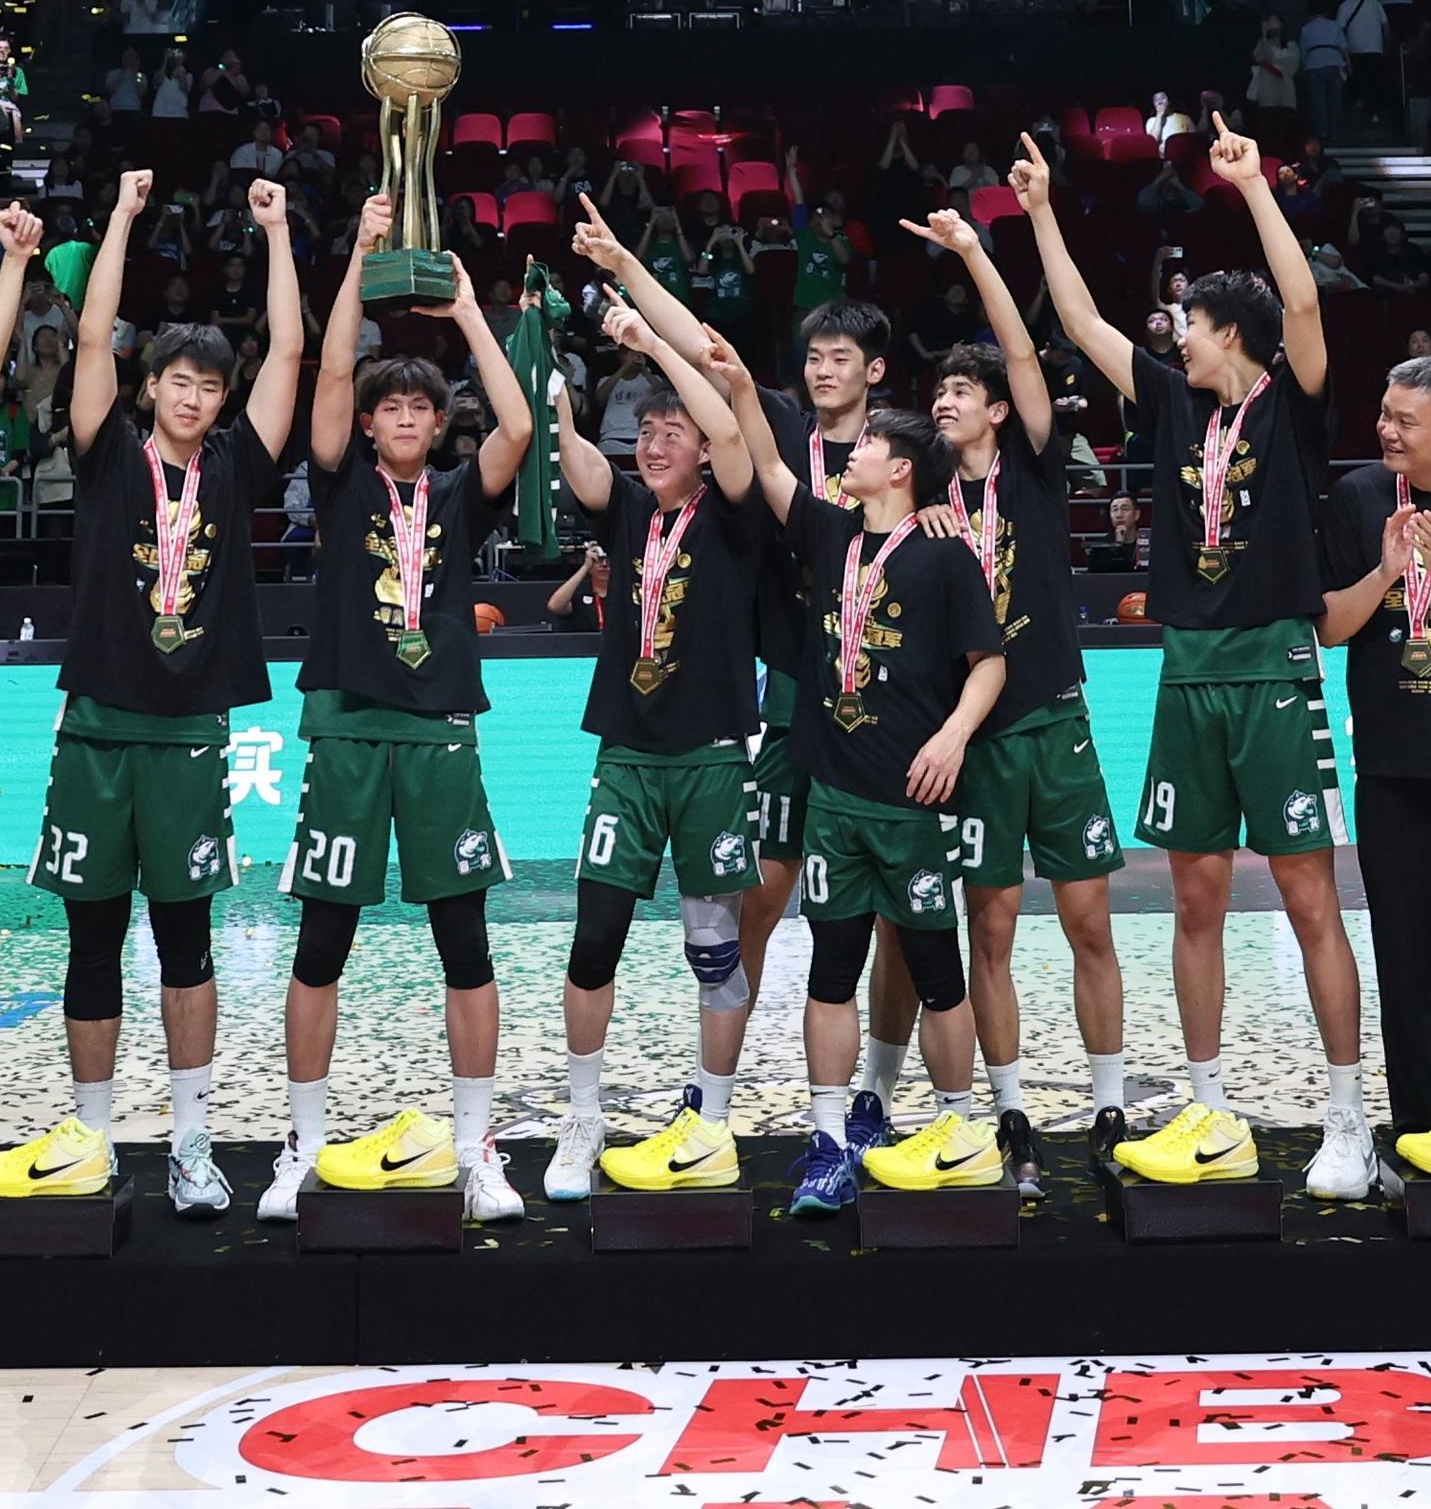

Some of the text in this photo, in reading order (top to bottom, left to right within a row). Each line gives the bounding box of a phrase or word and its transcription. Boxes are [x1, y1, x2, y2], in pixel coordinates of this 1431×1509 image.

[46, 825, 88, 883] 32
[303, 829, 356, 887] 20
[589, 814, 619, 866] 6
